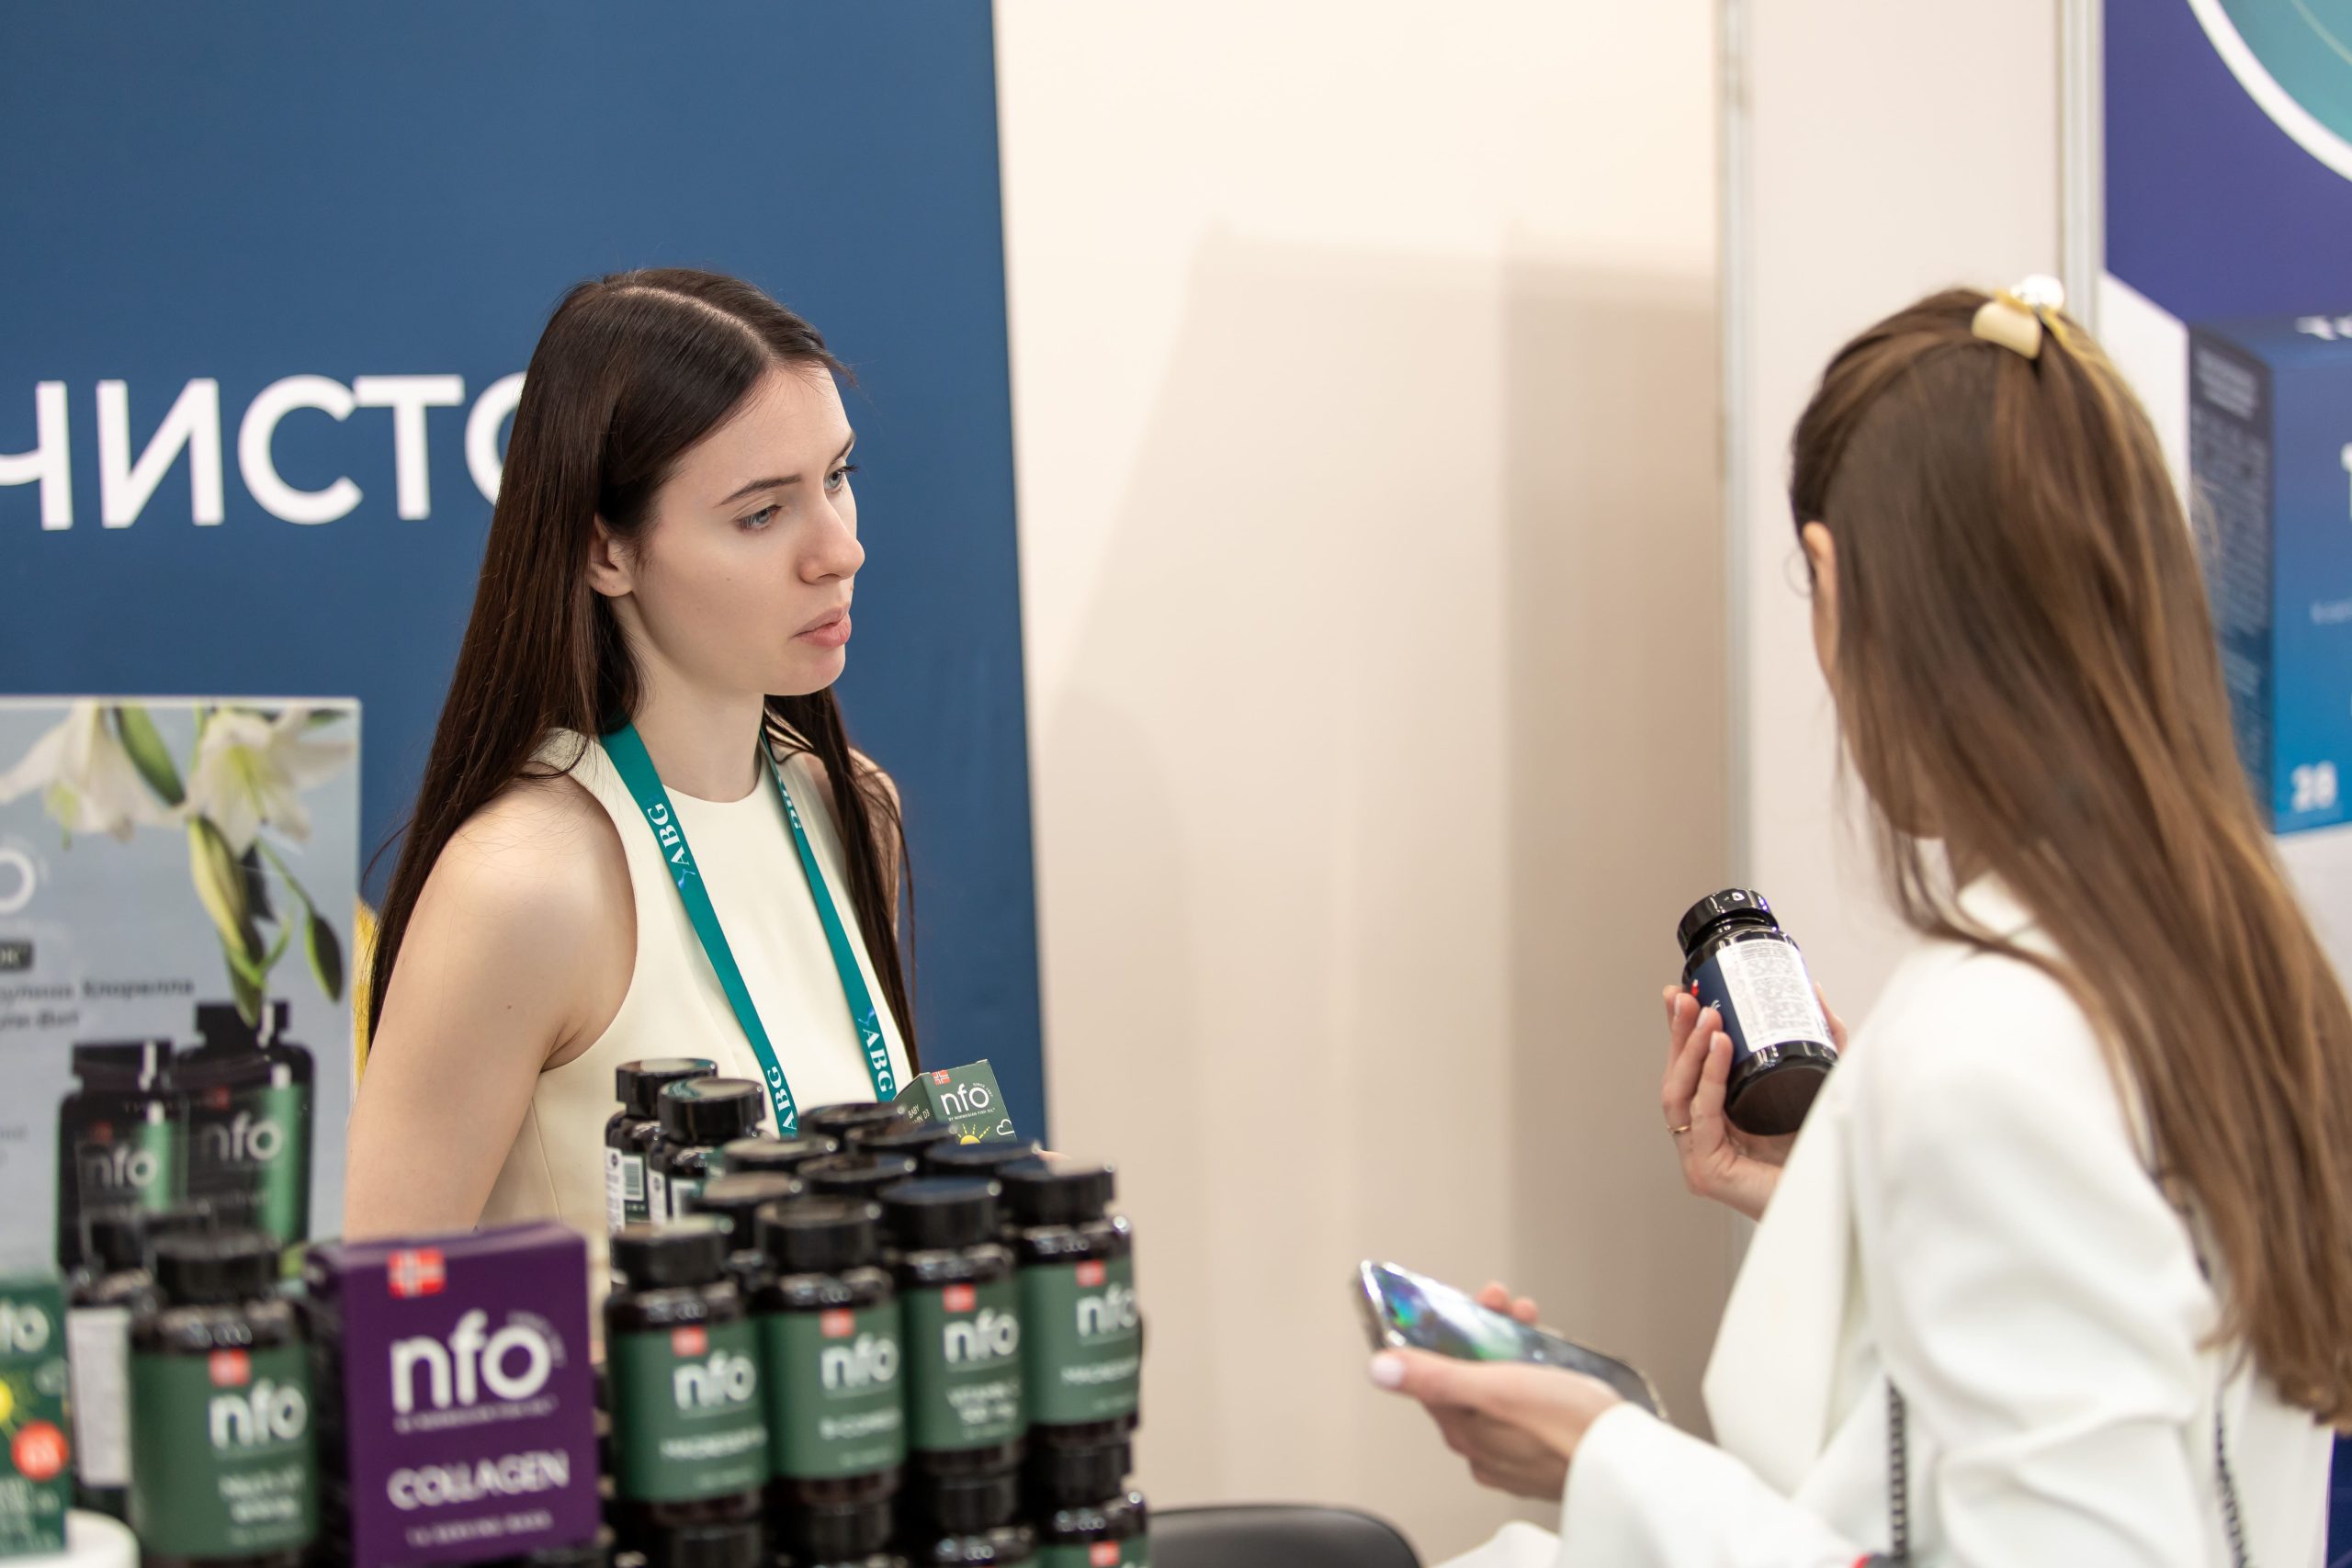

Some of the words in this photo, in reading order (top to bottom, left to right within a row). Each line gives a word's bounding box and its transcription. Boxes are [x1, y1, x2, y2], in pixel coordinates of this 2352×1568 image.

[647, 803, 690, 866] ABG
[863, 1028, 893, 1093] ABG
[766, 1066, 797, 1131] ABG
[940, 1082, 989, 1115] nfo
[88, 1143, 159, 1190] nfo
[201, 1109, 283, 1162] nfo
[944, 1306, 1021, 1364] nfo
[1076, 1283, 1138, 1337] nfo
[389, 1307, 552, 1415] nfo
[673, 1348, 757, 1411] nfo
[820, 1332, 900, 1391] nfo
[210, 1377, 308, 1449] nfo
[387, 1448, 571, 1511] COLLAGEN
